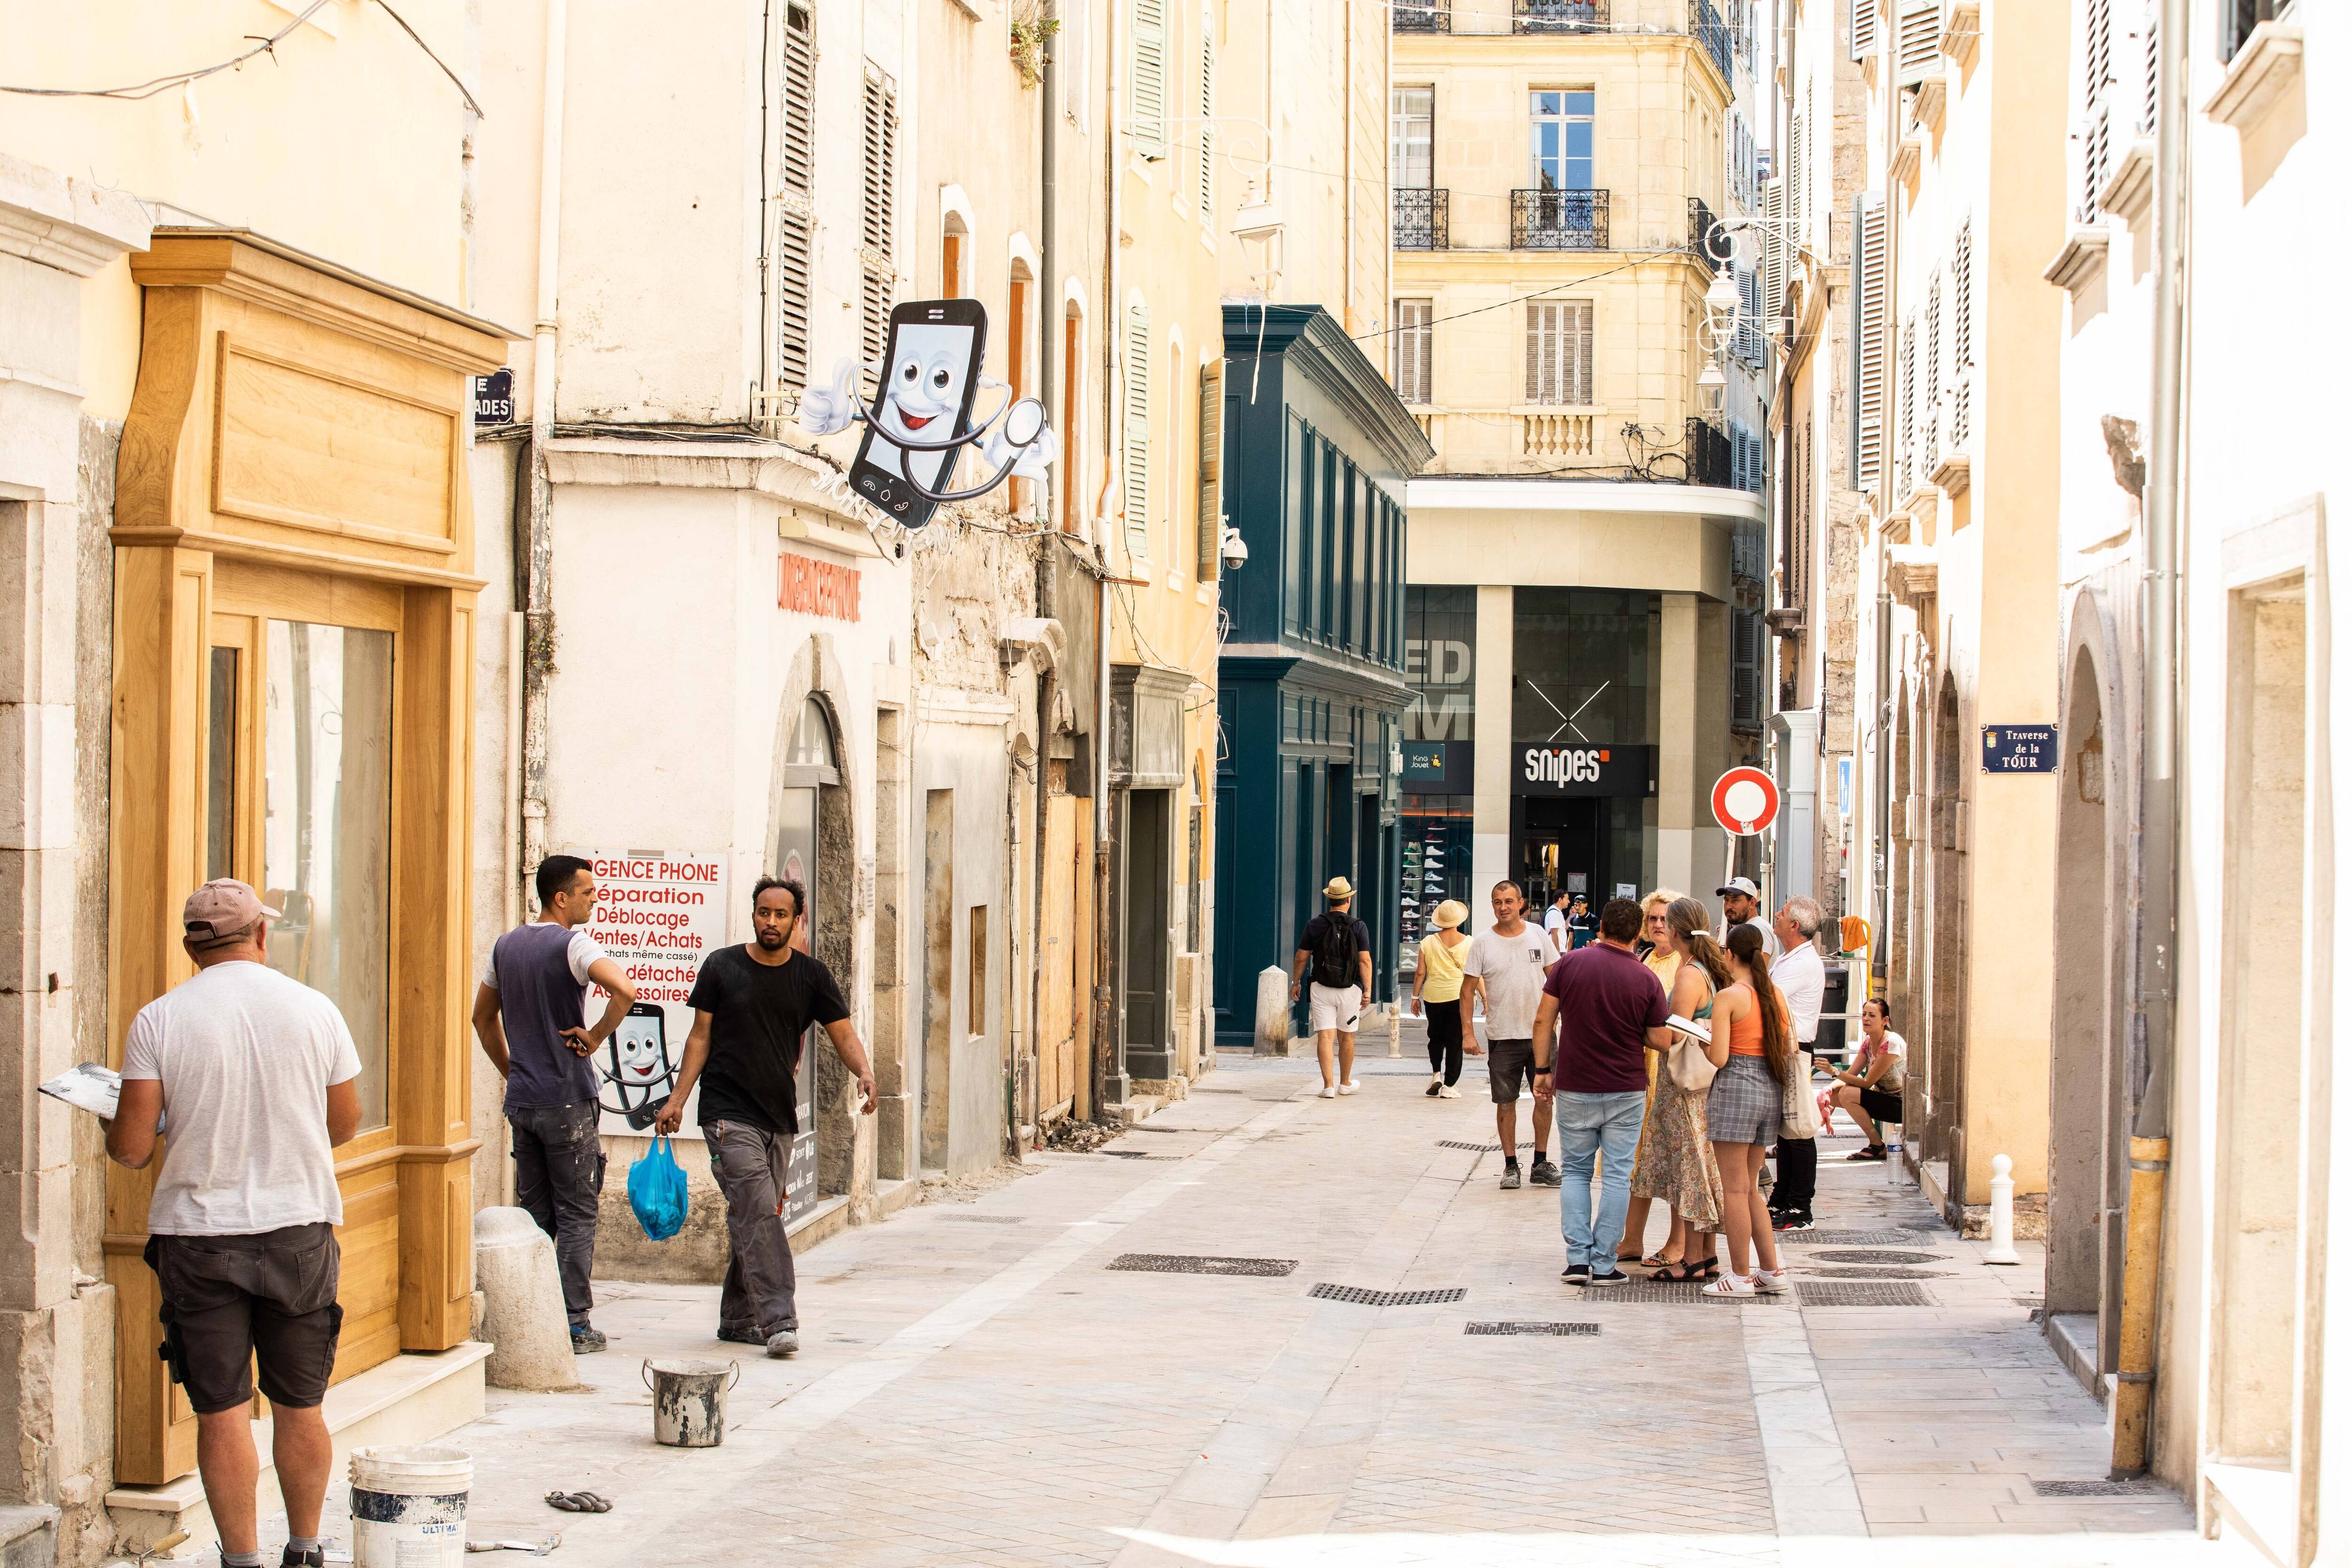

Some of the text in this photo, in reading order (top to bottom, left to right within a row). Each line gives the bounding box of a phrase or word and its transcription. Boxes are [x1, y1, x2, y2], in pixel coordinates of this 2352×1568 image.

[2015, 744, 2040, 753] de la
[1525, 748, 1600, 788] snipes
[2002, 756, 2038, 768] TOUR
[660, 862, 718, 881] PHONE
[594, 883, 704, 905] éparation
[597, 906, 689, 930] Déblocage
[632, 950, 663, 959] même
[666, 952, 698, 963] cassé)
[626, 963, 700, 983] détaché
[592, 984, 690, 1002] Acssoires
